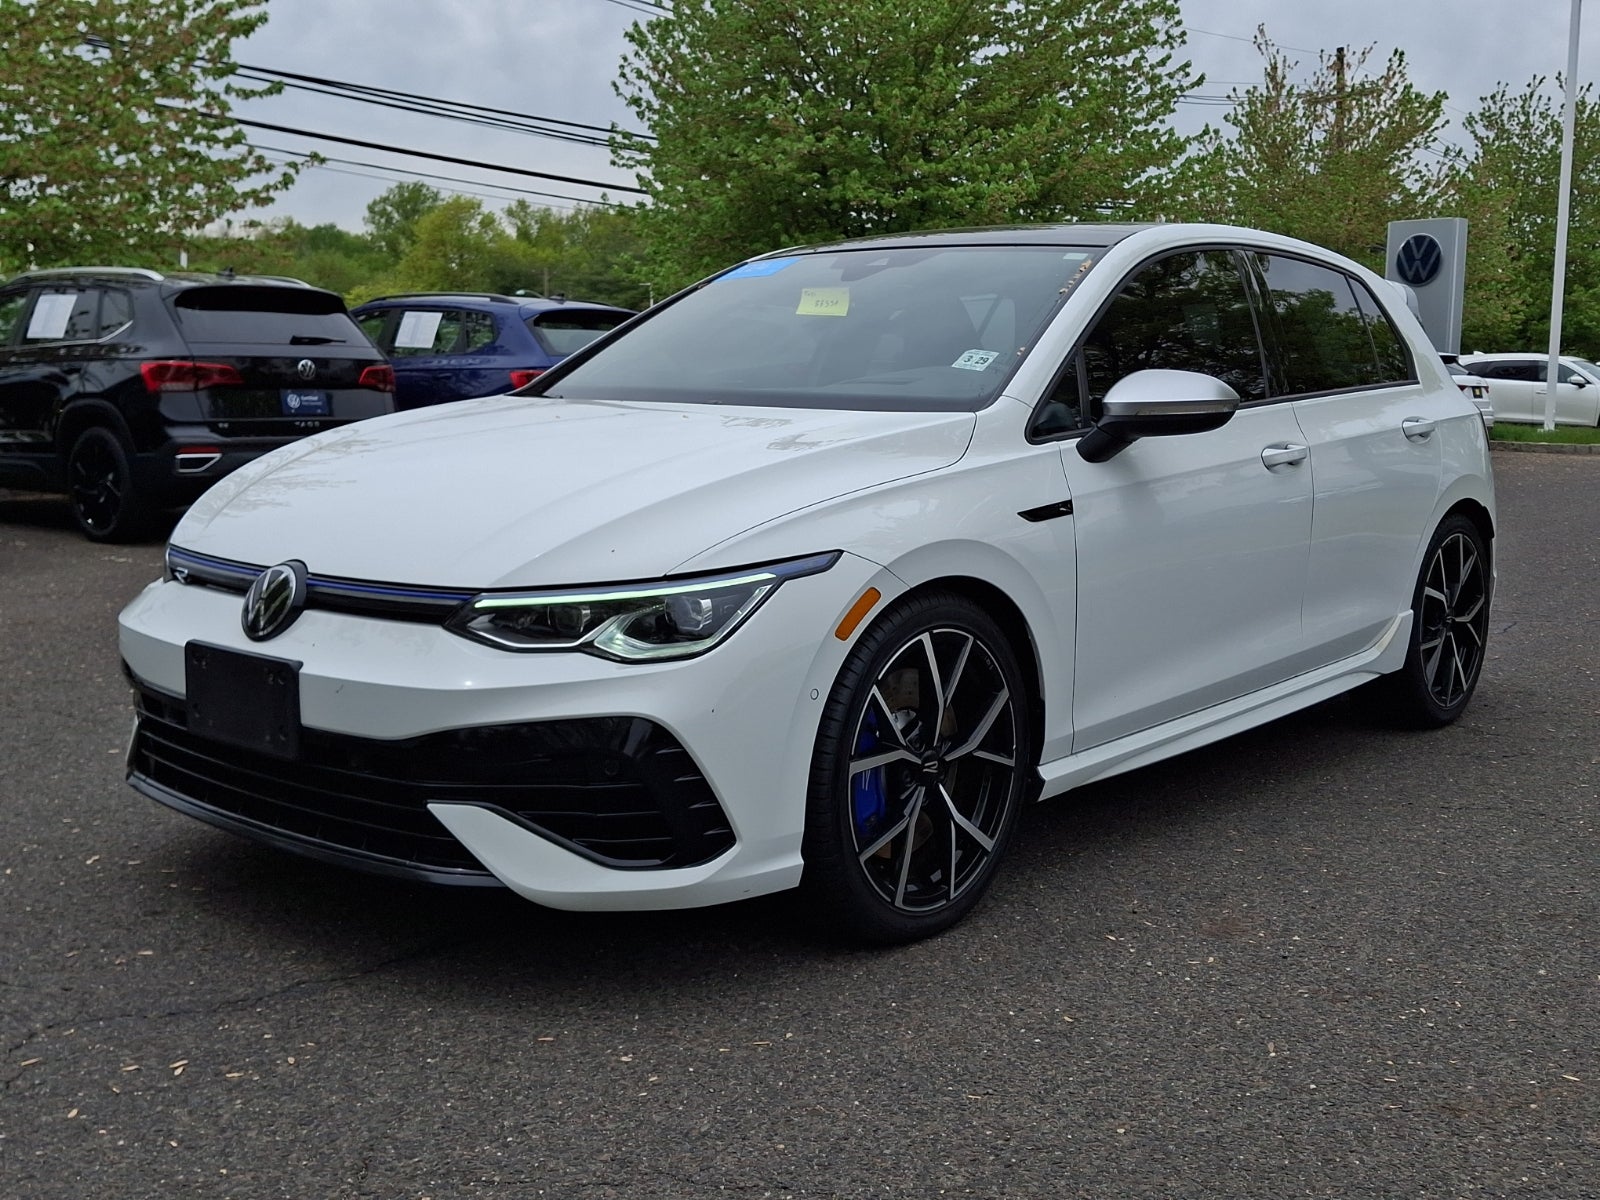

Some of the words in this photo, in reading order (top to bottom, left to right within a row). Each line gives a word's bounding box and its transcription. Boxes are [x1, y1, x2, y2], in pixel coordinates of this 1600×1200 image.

[1398, 235, 1442, 283] VW
[963, 355, 974, 363] 3
[974, 356, 990, 365] 29
[243, 563, 296, 637] VW
